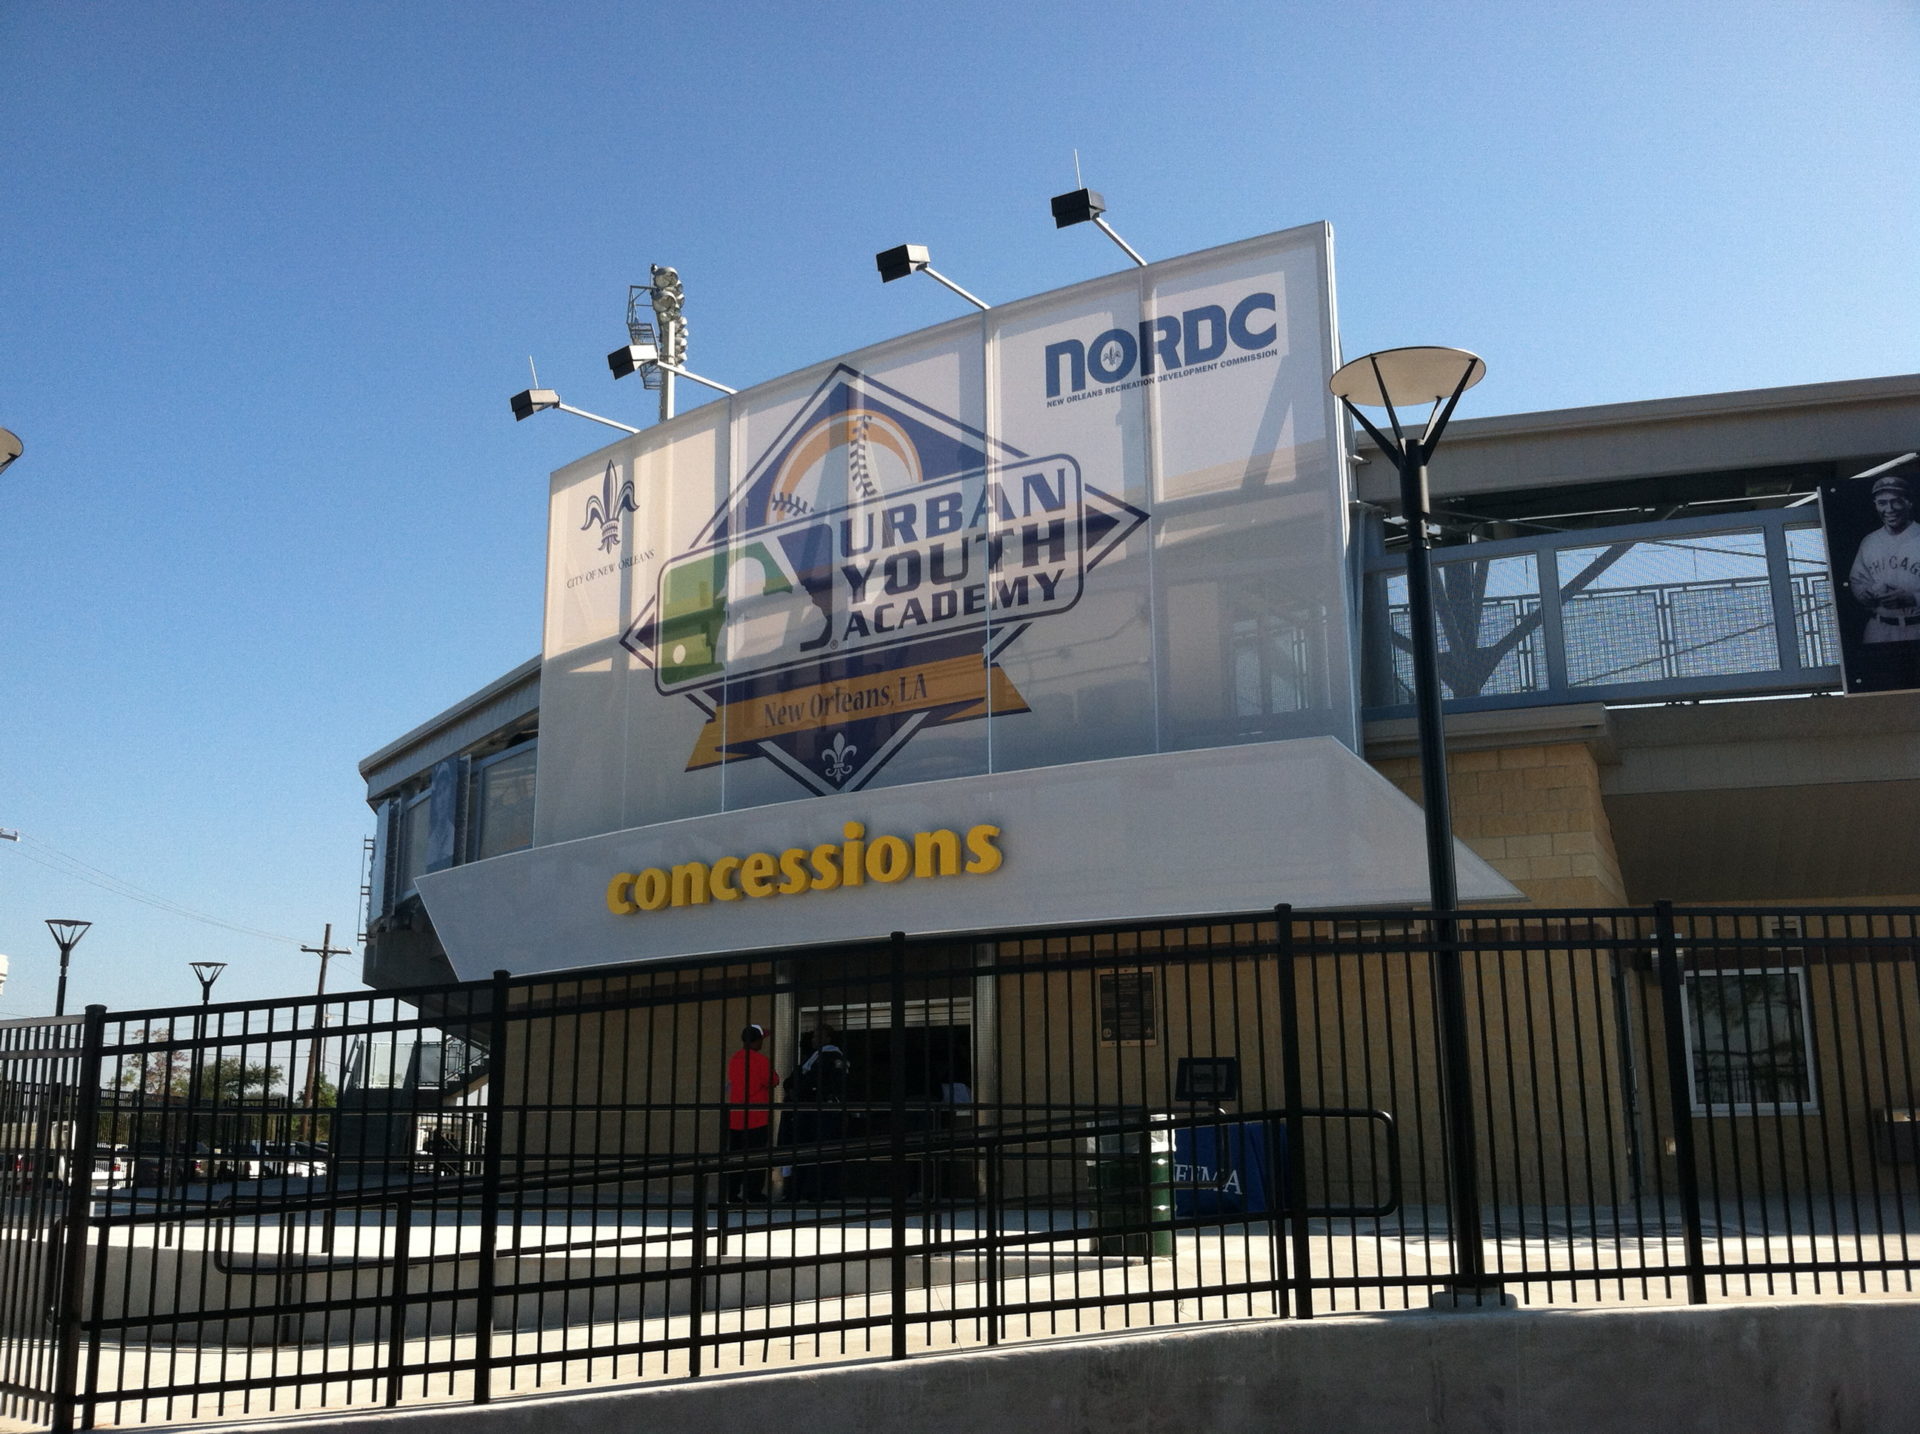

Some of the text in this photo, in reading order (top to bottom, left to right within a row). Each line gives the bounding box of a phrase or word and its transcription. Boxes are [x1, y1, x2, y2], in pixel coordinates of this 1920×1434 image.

[1047, 349, 1278, 408] NEW ORLEANS RECREATION DEVELOPMENT COMMISSION
[840, 468, 1066, 558] URBAN
[567, 549, 655, 588] CITY OF NEW ORLEANS
[841, 518, 1066, 604] YOUTH
[842, 569, 1065, 641] ACADEMY
[764, 673, 928, 729] New Orleans, LA
[607, 821, 1002, 916] concessions
